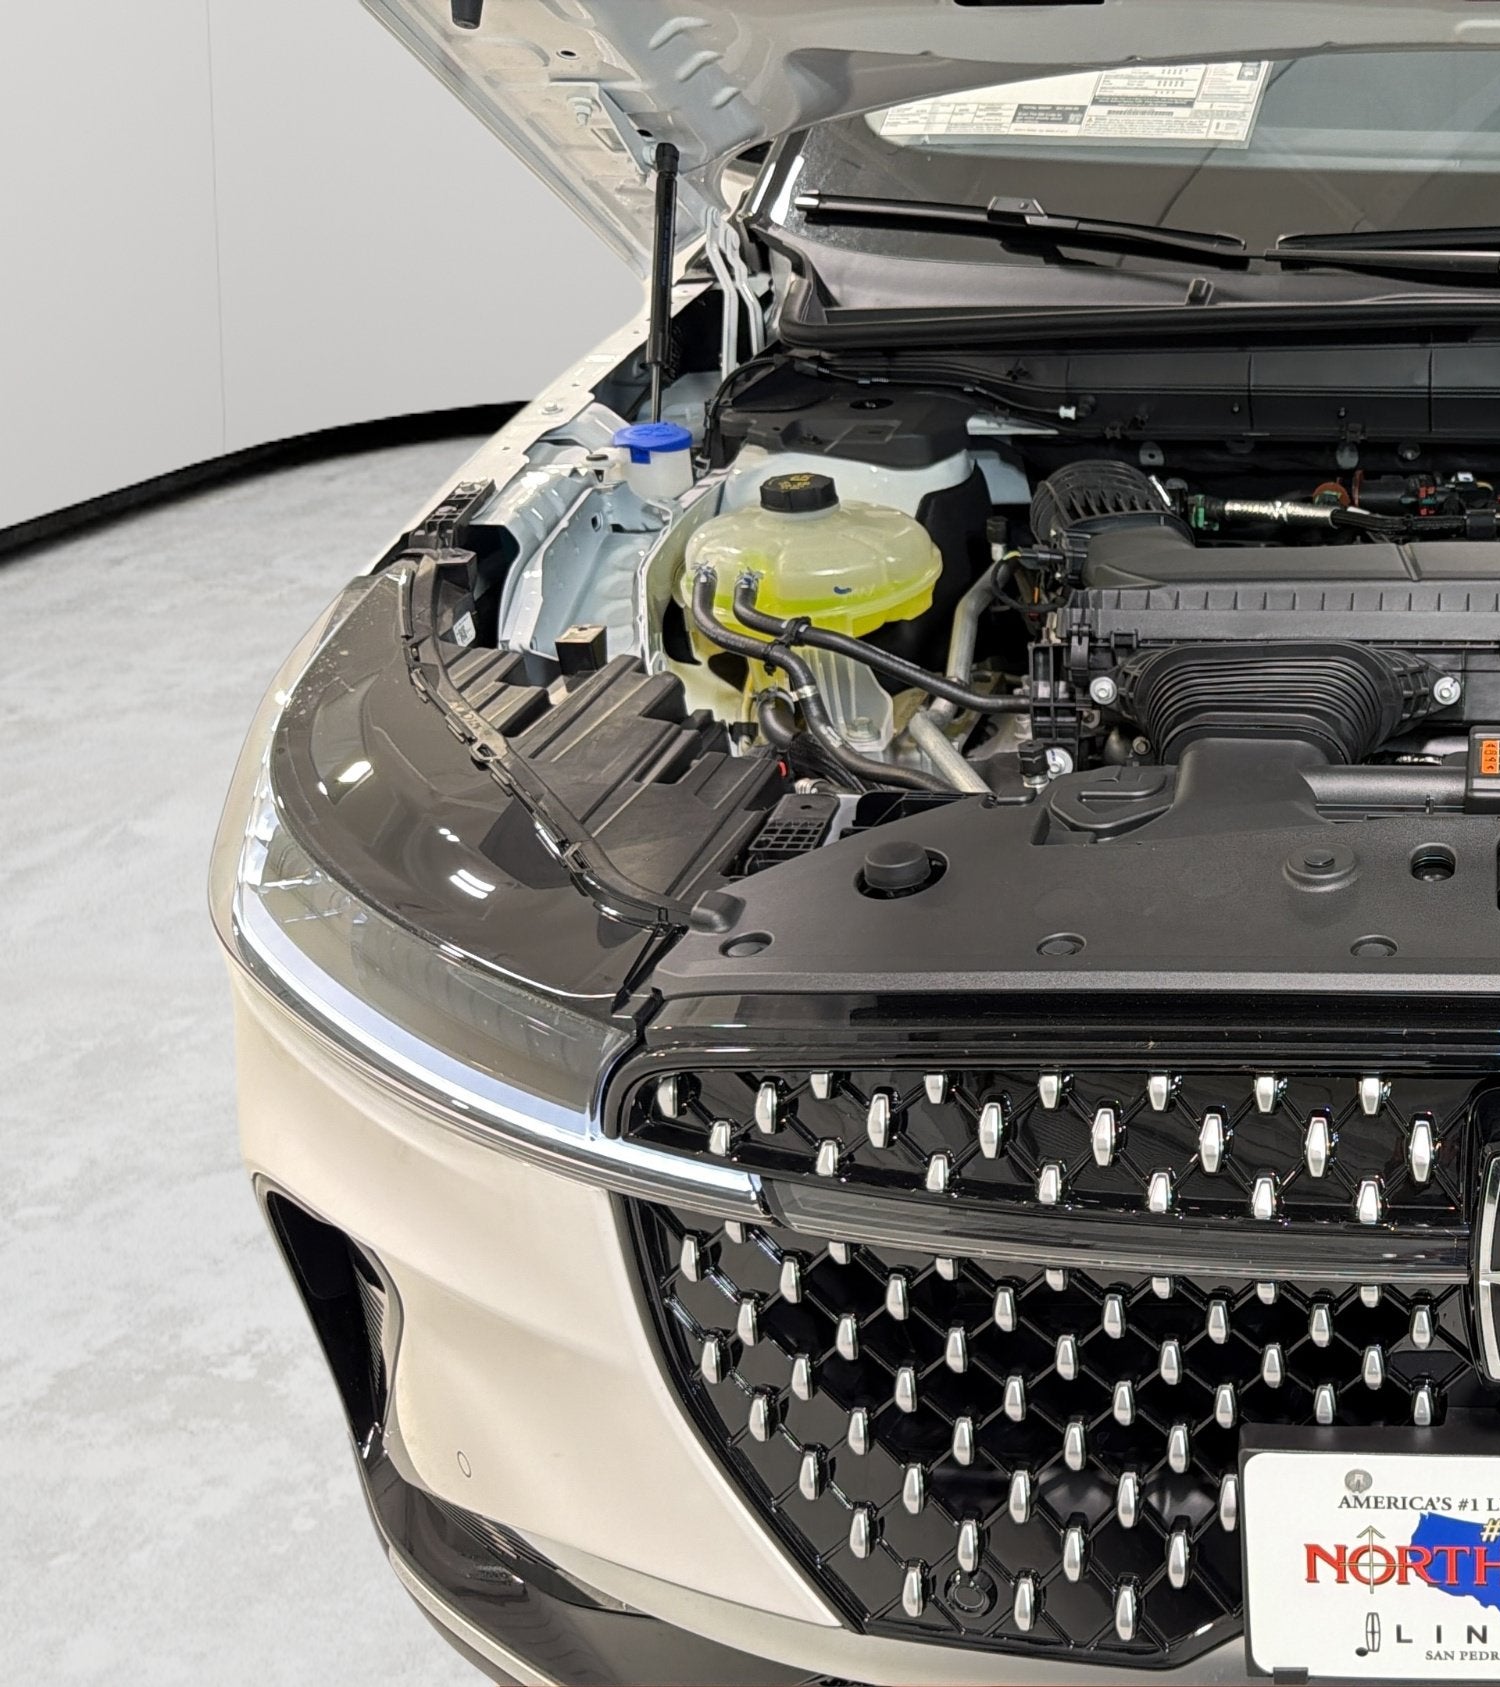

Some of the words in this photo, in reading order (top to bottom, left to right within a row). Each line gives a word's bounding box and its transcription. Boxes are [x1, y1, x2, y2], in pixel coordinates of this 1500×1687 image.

[1337, 1495, 1452, 1511] AMERICA'S
[1458, 1497, 1479, 1512] #1
[1425, 1649, 1455, 1661] SAN
